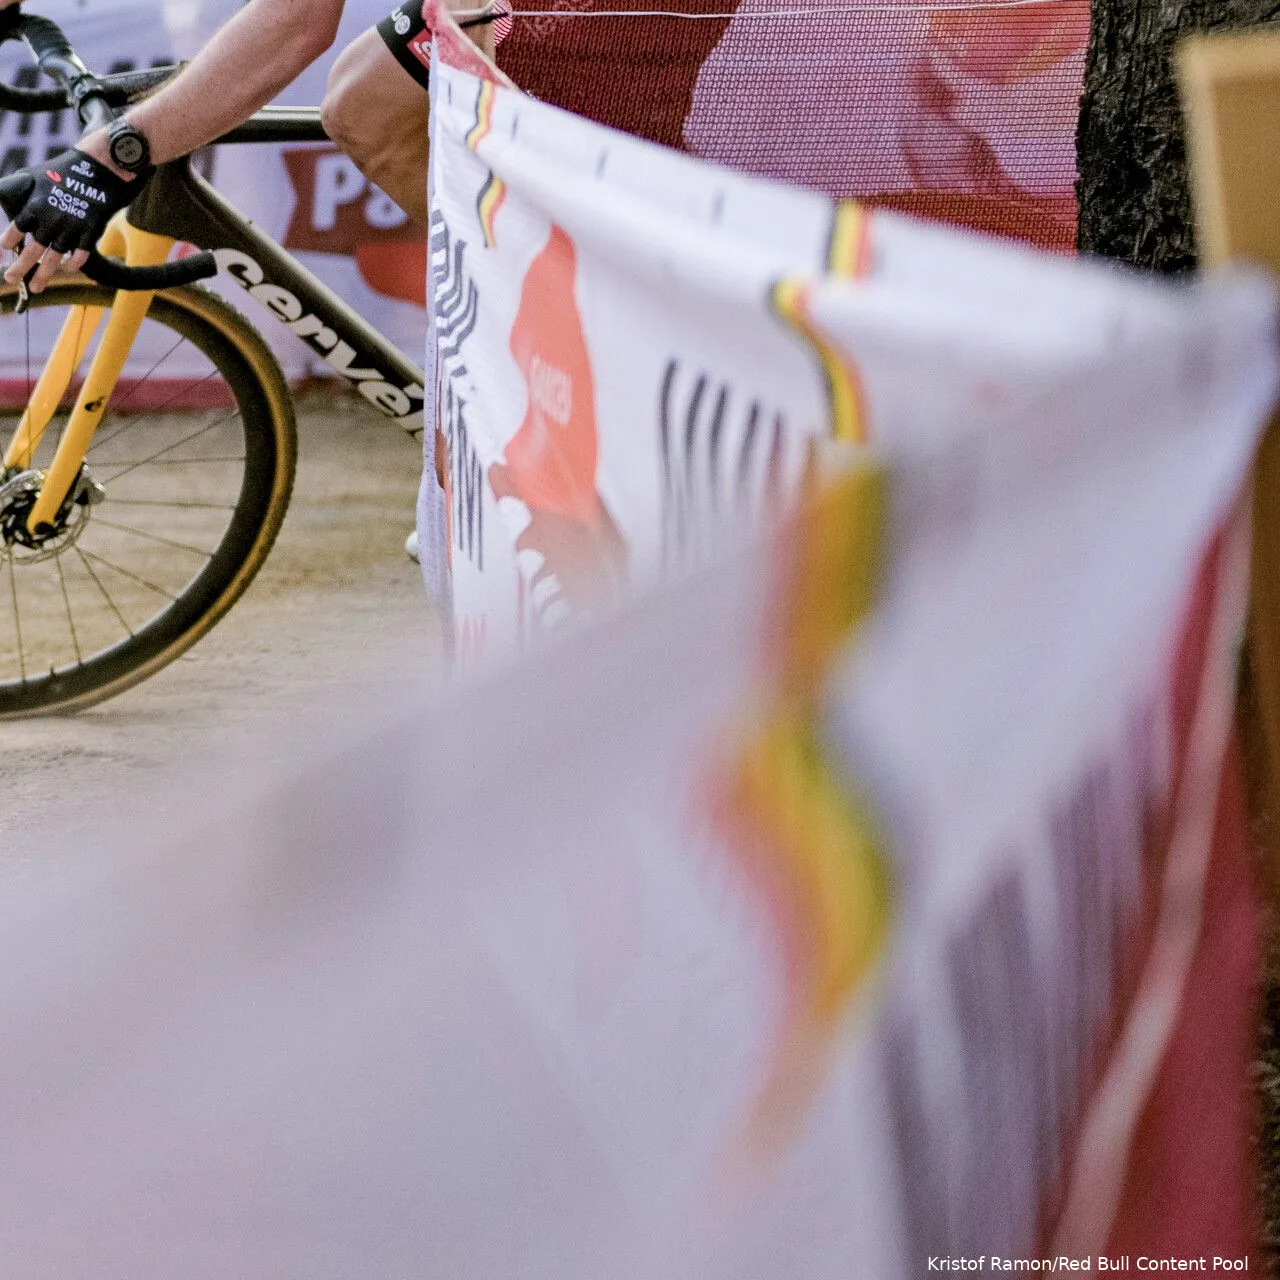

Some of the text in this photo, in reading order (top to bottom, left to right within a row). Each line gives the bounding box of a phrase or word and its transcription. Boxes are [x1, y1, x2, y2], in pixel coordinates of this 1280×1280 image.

[50, 185, 89, 210] lease
[65, 176, 107, 204] VISMA
[213, 247, 425, 442] Cervé
